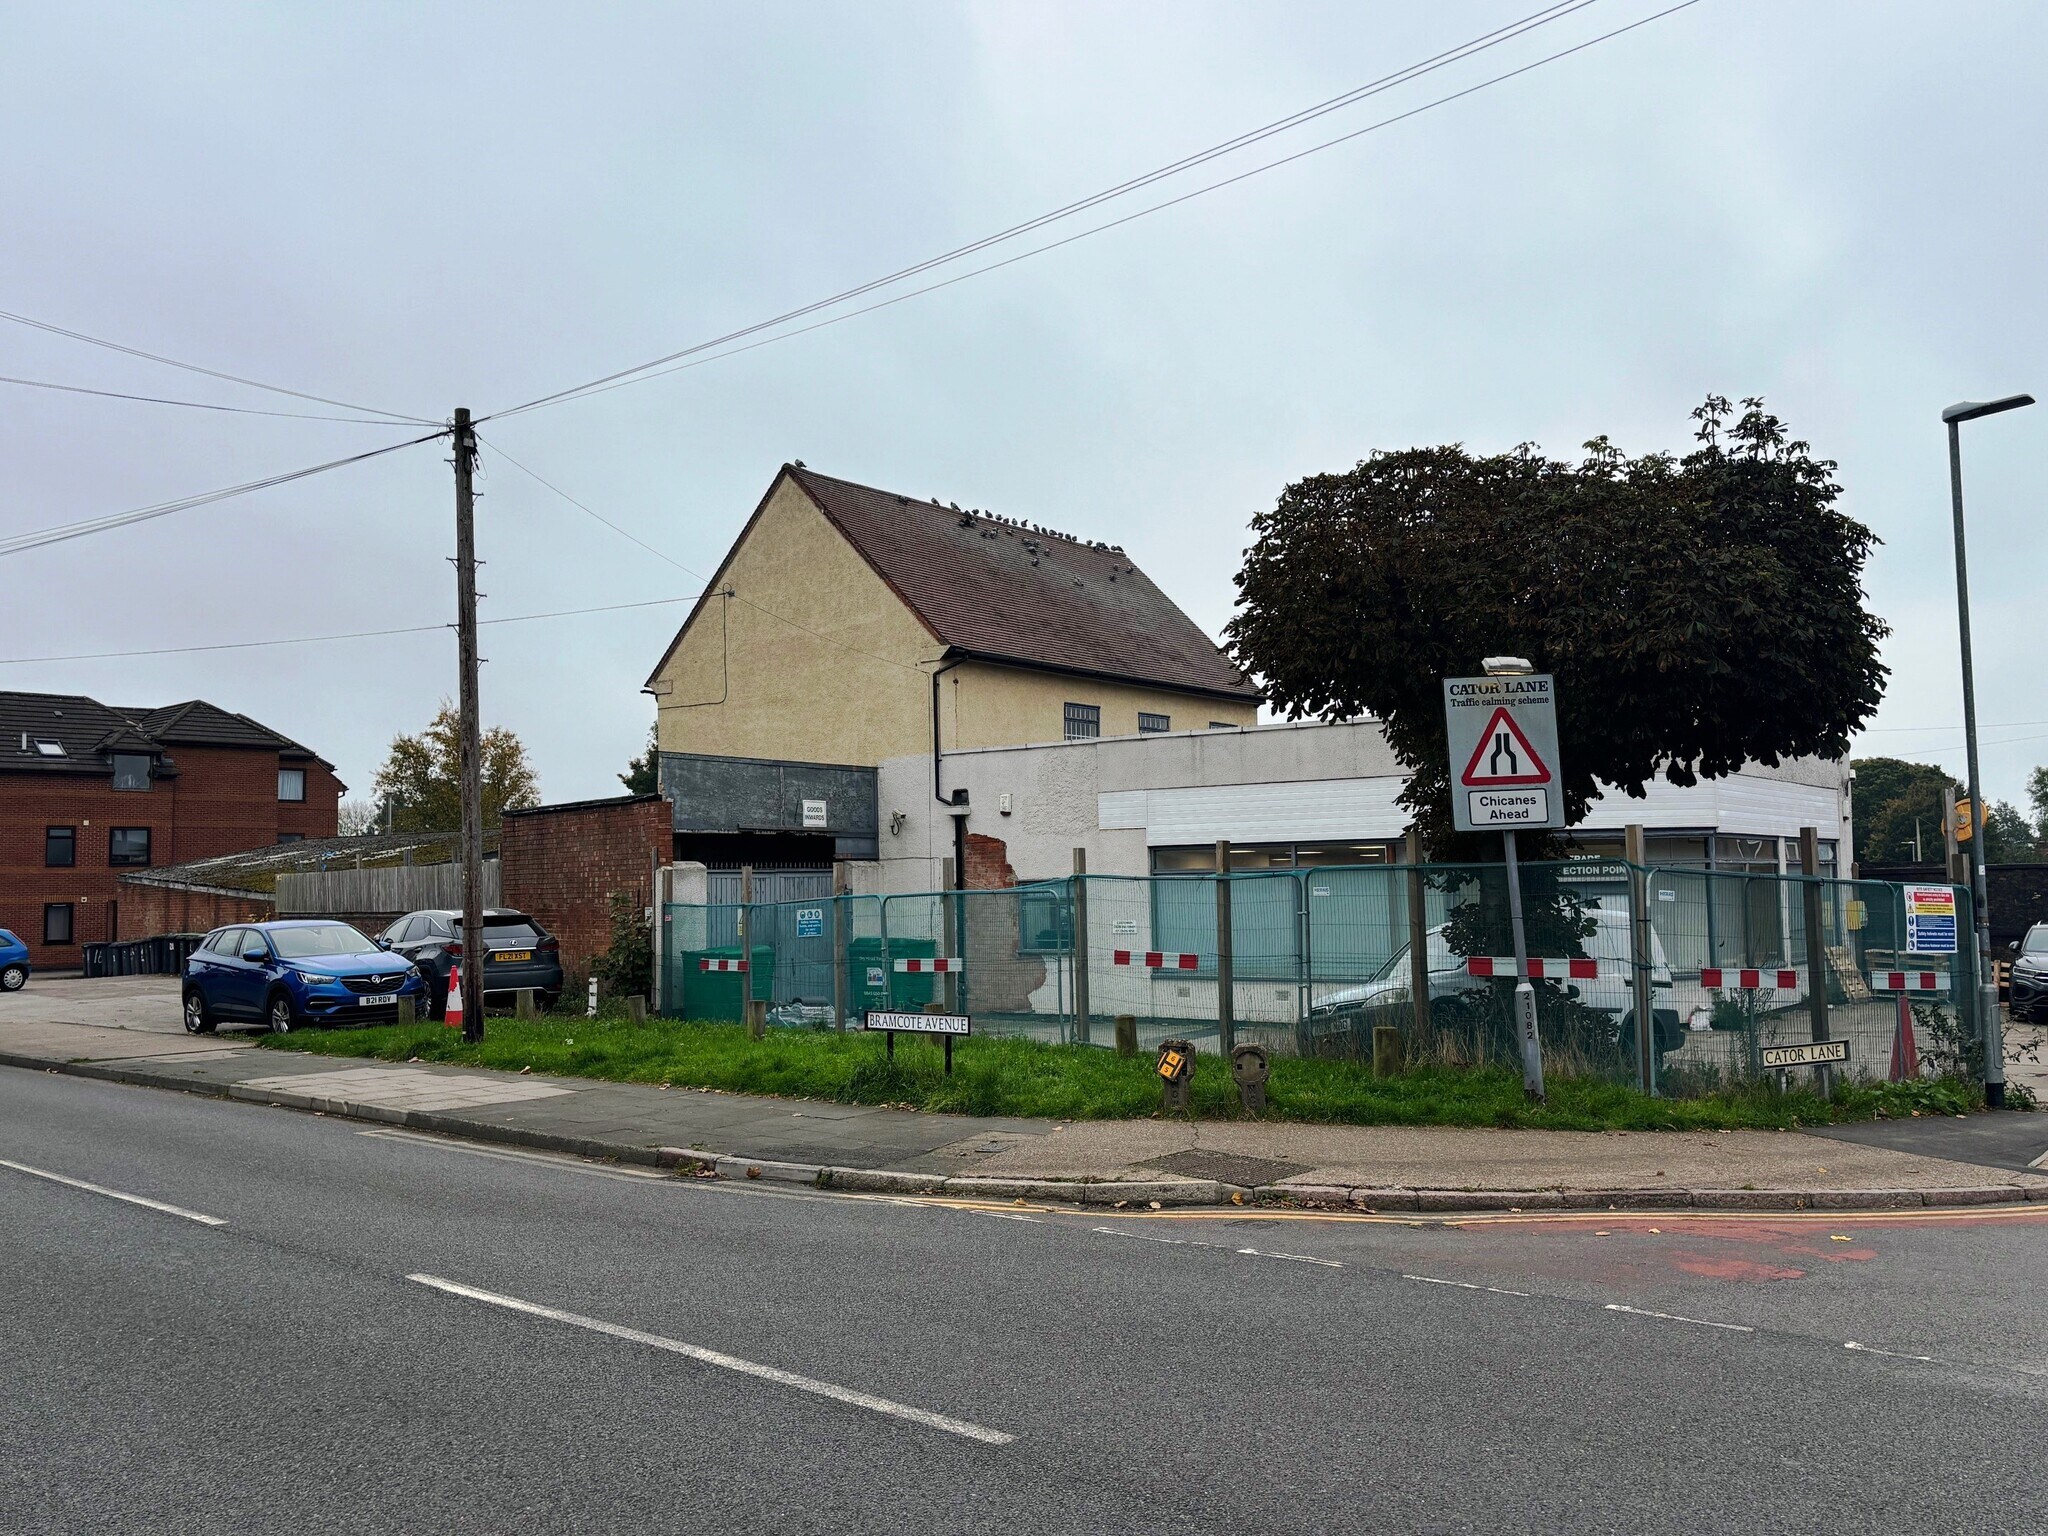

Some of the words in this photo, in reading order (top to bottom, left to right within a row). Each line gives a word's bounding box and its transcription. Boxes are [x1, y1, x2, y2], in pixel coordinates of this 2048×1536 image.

[1449, 683, 1501, 696] CATOR
[1504, 680, 1549, 693] LANE
[1450, 697, 1480, 707] Traffic
[1482, 697, 1516, 707] calming
[1518, 695, 1550, 705] scheme
[1479, 795, 1537, 807] Chicanes
[1489, 808, 1529, 820] Ahead
[1562, 866, 1600, 875] ECTION
[1602, 865, 1627, 874] POIN
[365, 997, 377, 1005] B21
[1523, 992, 1533, 1039] 21082
[869, 1014, 922, 1030] BRAMCOTE
[925, 1018, 967, 1032] AVENUE
[1765, 1048, 1806, 1064] CATOR
[1811, 1044, 1842, 1060] LANE
